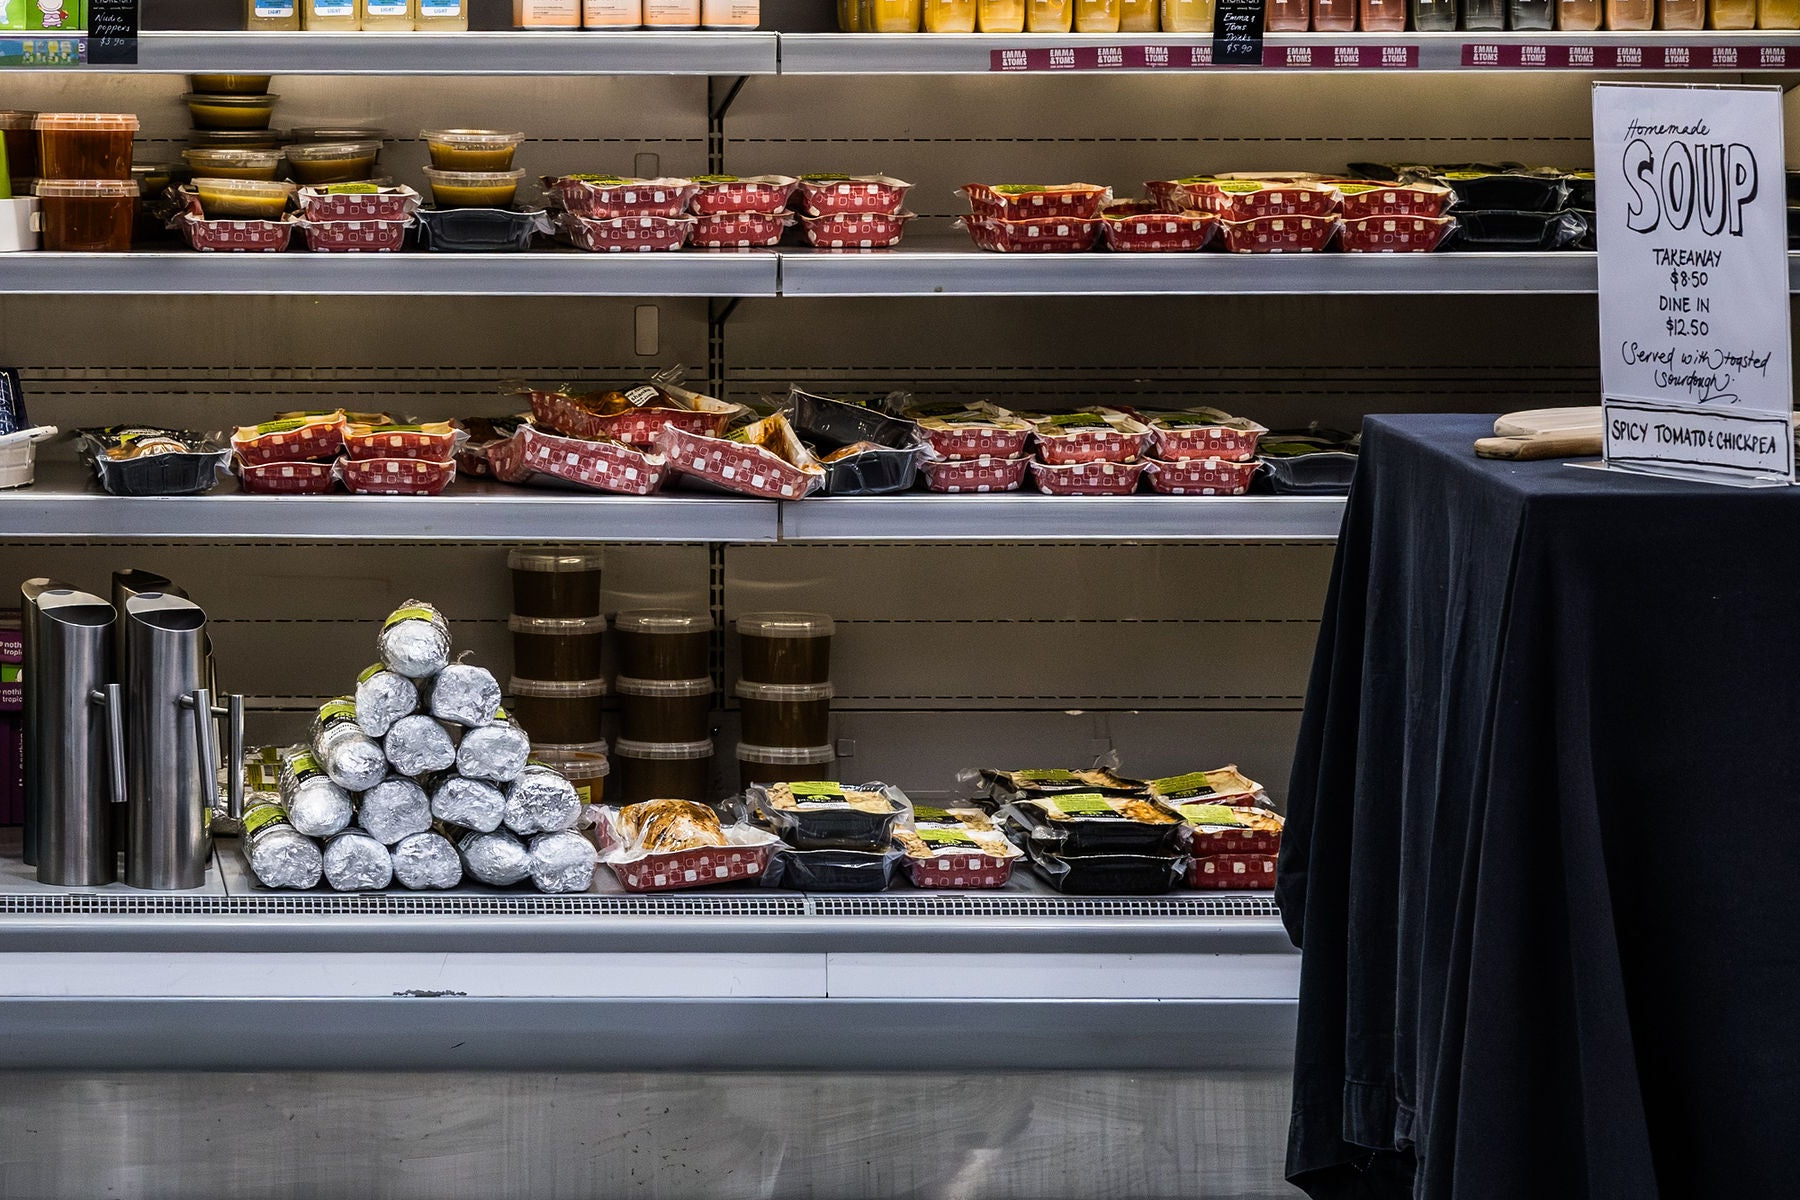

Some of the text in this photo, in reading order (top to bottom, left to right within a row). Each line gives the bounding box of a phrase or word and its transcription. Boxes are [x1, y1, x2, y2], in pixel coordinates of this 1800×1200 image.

[1223, 12, 1249, 22] Emma
[1225, 22, 1247, 32] Toms
[1223, 32, 1251, 42] Drinks
[1624, 118, 1710, 141] Homemade
[1622, 139, 1758, 237] SOUP
[1652, 248, 1722, 267] TAKEAWAY
[1670, 268, 1709, 291] $8.50
[1659, 295, 1710, 313] DINE IN
[1665, 316, 1709, 337] $12.50
[1621, 341, 1771, 377] Served with toasted
[1611, 419, 1776, 454] SPICY TOMATO & CHICKPEA
